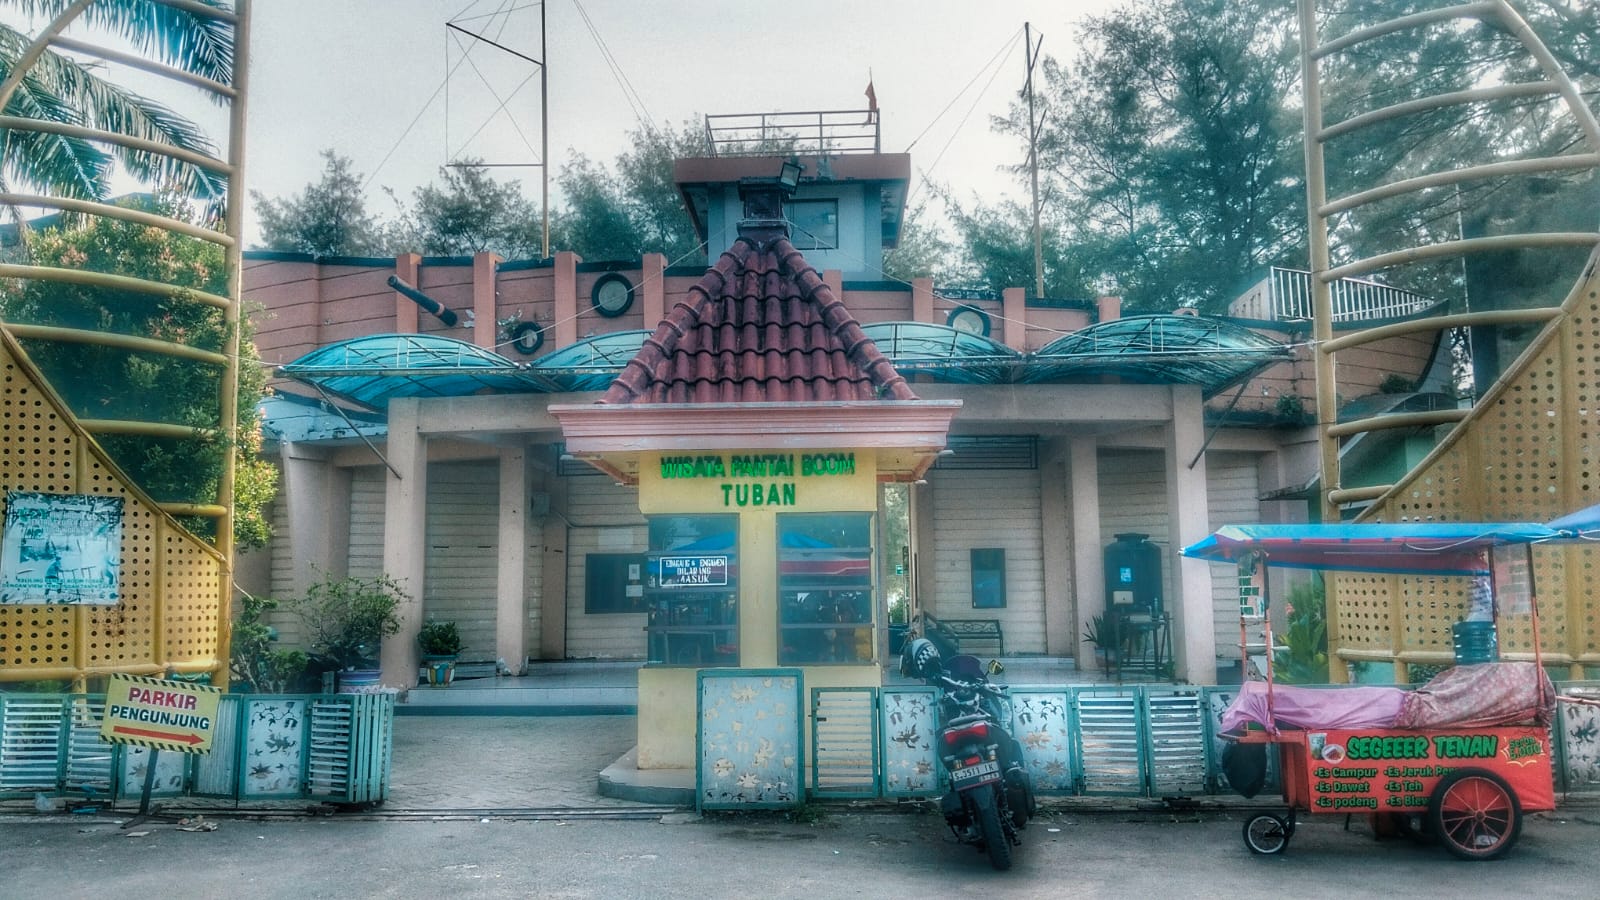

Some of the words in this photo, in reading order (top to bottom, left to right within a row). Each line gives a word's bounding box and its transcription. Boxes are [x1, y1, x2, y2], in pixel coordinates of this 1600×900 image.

[660, 455, 726, 479] WISATA
[731, 453, 794, 478] PANTAI
[801, 452, 856, 477] BOOM
[720, 483, 796, 506] TUBAN
[128, 687, 198, 710] PARKIR
[110, 705, 210, 730] PENGUNJUNG
[1346, 735, 1430, 759] SEGEEER
[1432, 735, 1498, 758] TENAN
[1332, 767, 1378, 780] Campur
[1402, 766, 1432, 777] Jeruk
[1435, 766, 1458, 776] Per
[1333, 782, 1370, 792] Dawet
[1403, 781, 1423, 791] Teh
[1334, 796, 1378, 809] podeng
